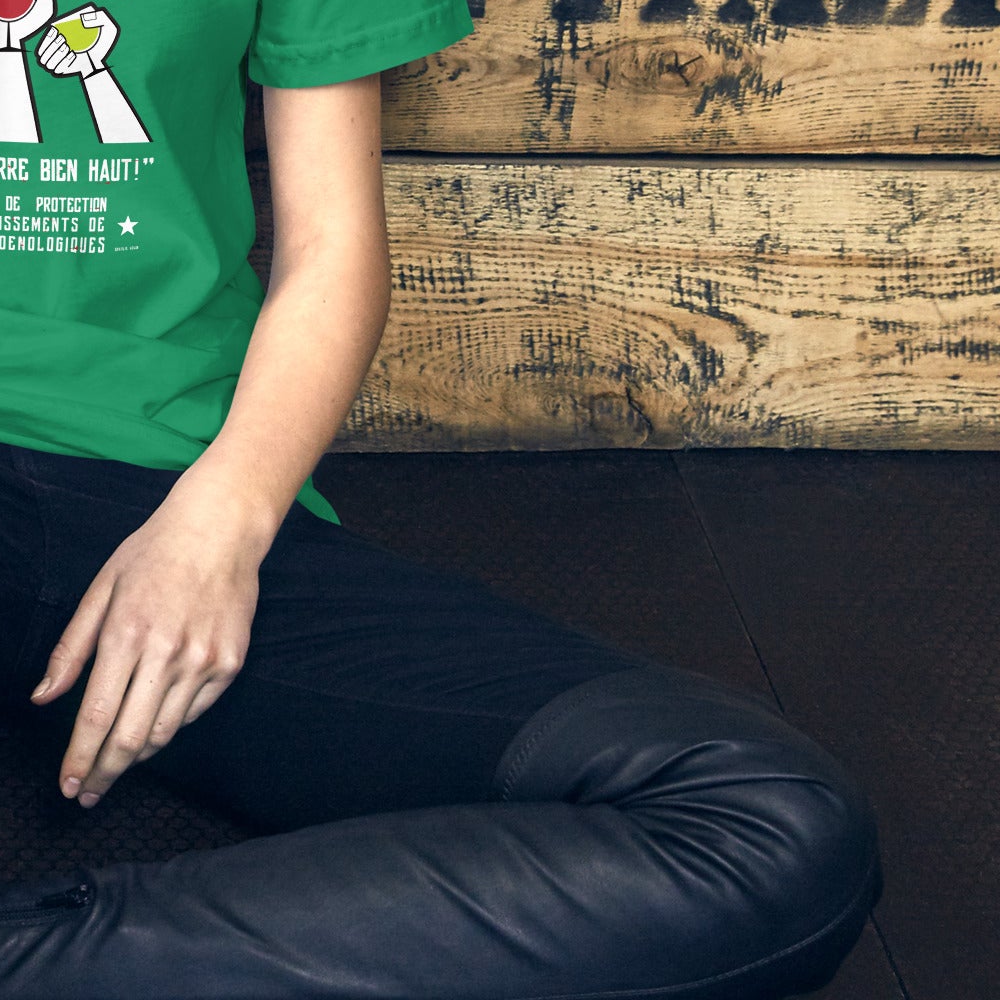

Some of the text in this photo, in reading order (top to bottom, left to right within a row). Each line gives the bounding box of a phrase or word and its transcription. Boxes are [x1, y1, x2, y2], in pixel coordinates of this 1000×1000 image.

[40, 158, 78, 182] BIEN
[5, 195, 21, 212] DE
[35, 196, 108, 213] PROTECTION
[88, 216, 105, 233] DE
